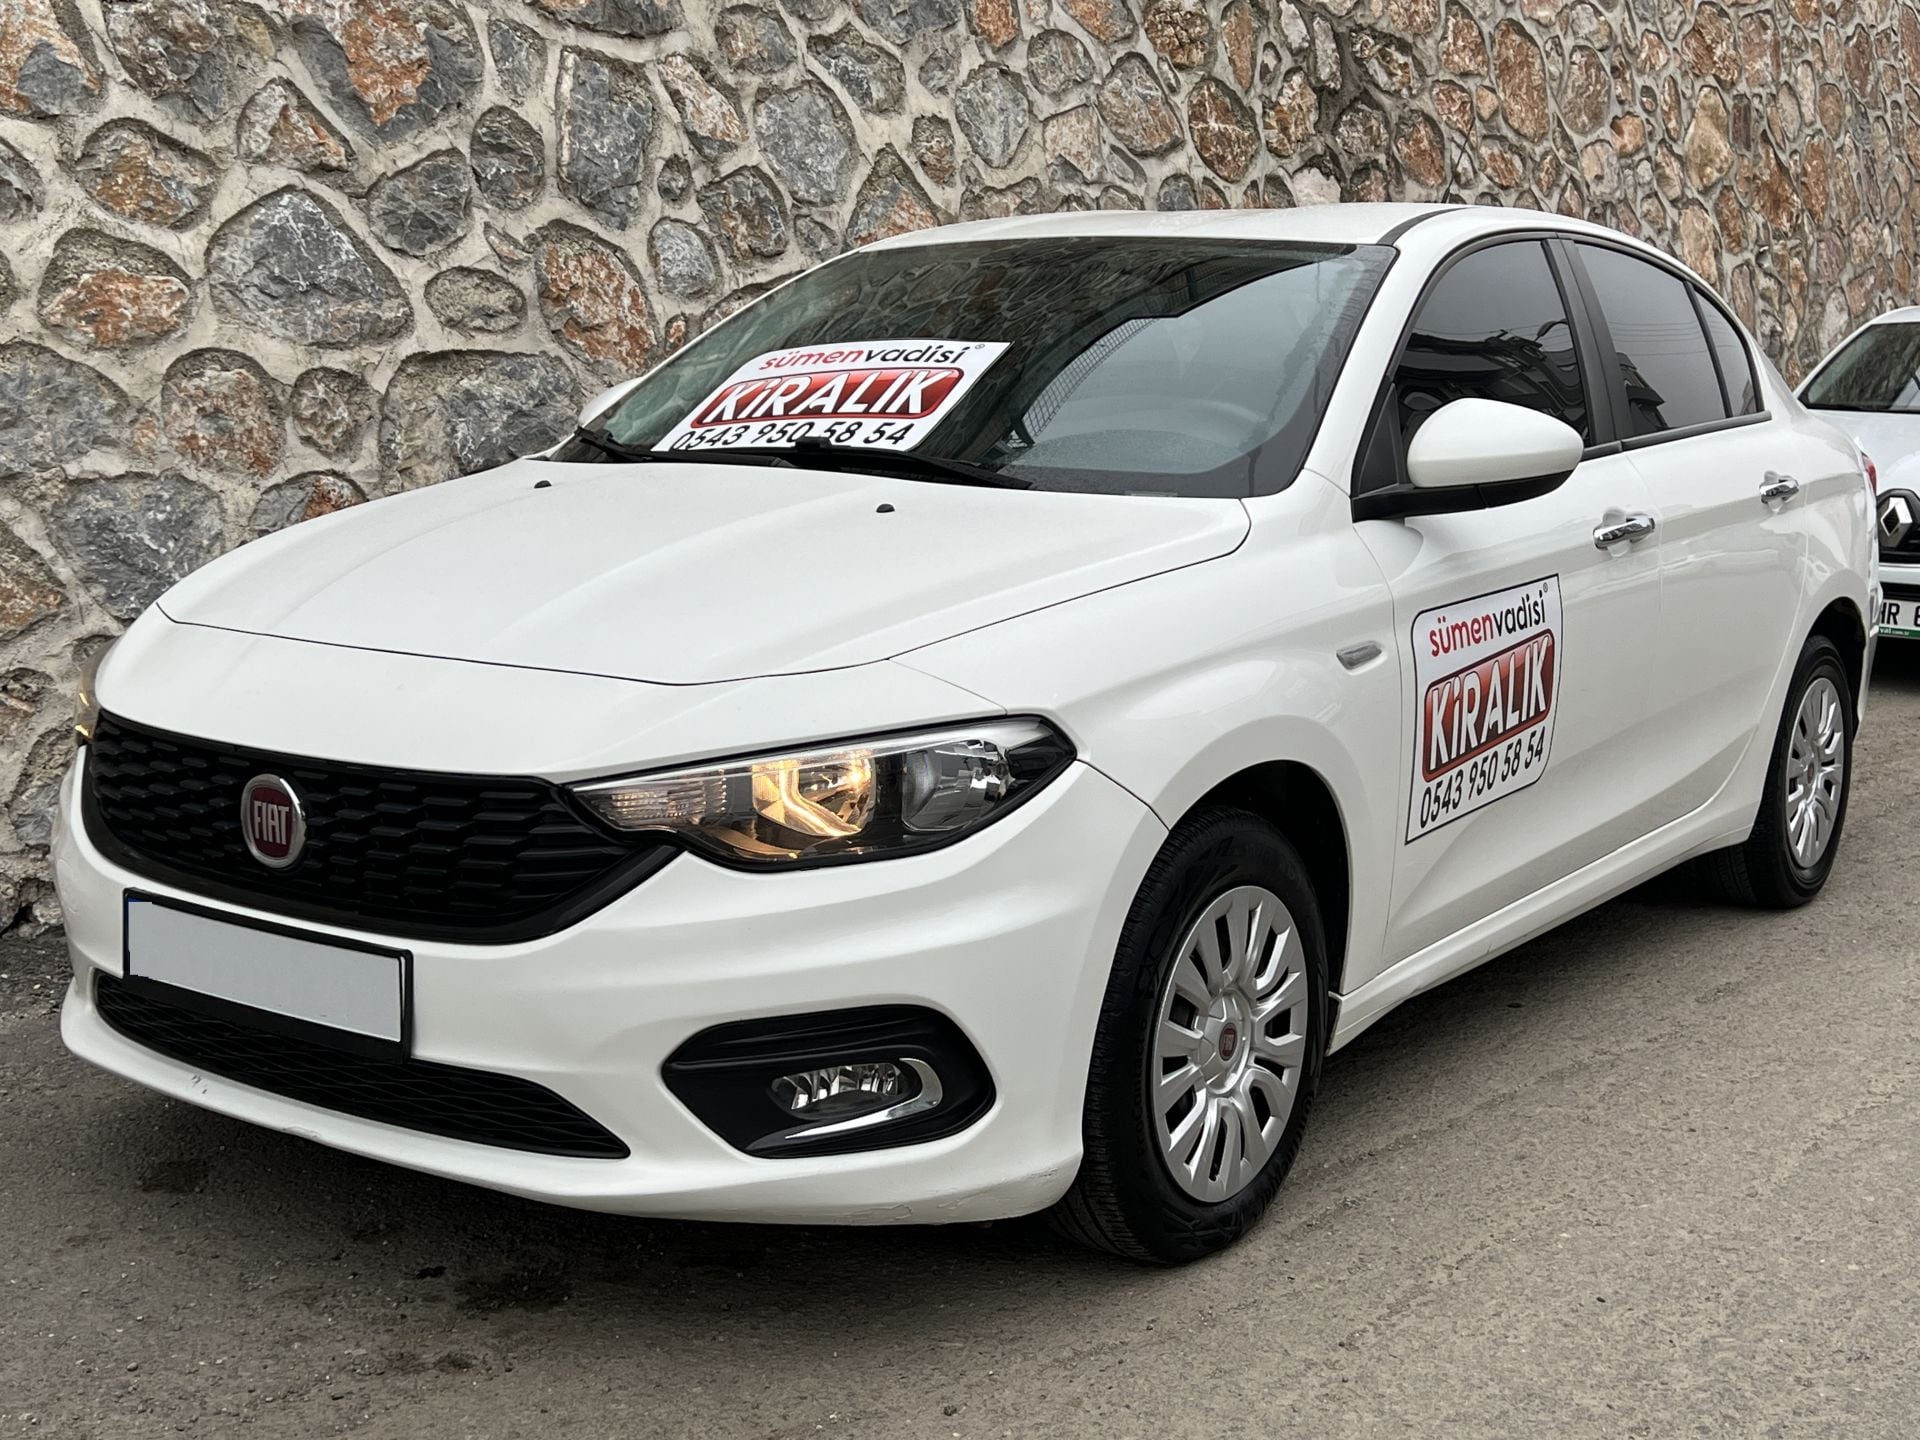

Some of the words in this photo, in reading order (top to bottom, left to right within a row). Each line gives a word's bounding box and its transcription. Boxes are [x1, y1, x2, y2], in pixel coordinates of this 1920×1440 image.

[671, 425, 747, 451] 0543
[752, 422, 814, 445] 950
[824, 422, 864, 444] 58
[865, 423, 914, 444] 54
[1420, 770, 1463, 828] 0543
[1468, 751, 1498, 800] 950
[1501, 738, 1520, 783] 58
[1524, 725, 1546, 770] 54
[254, 800, 289, 845] FIAT
